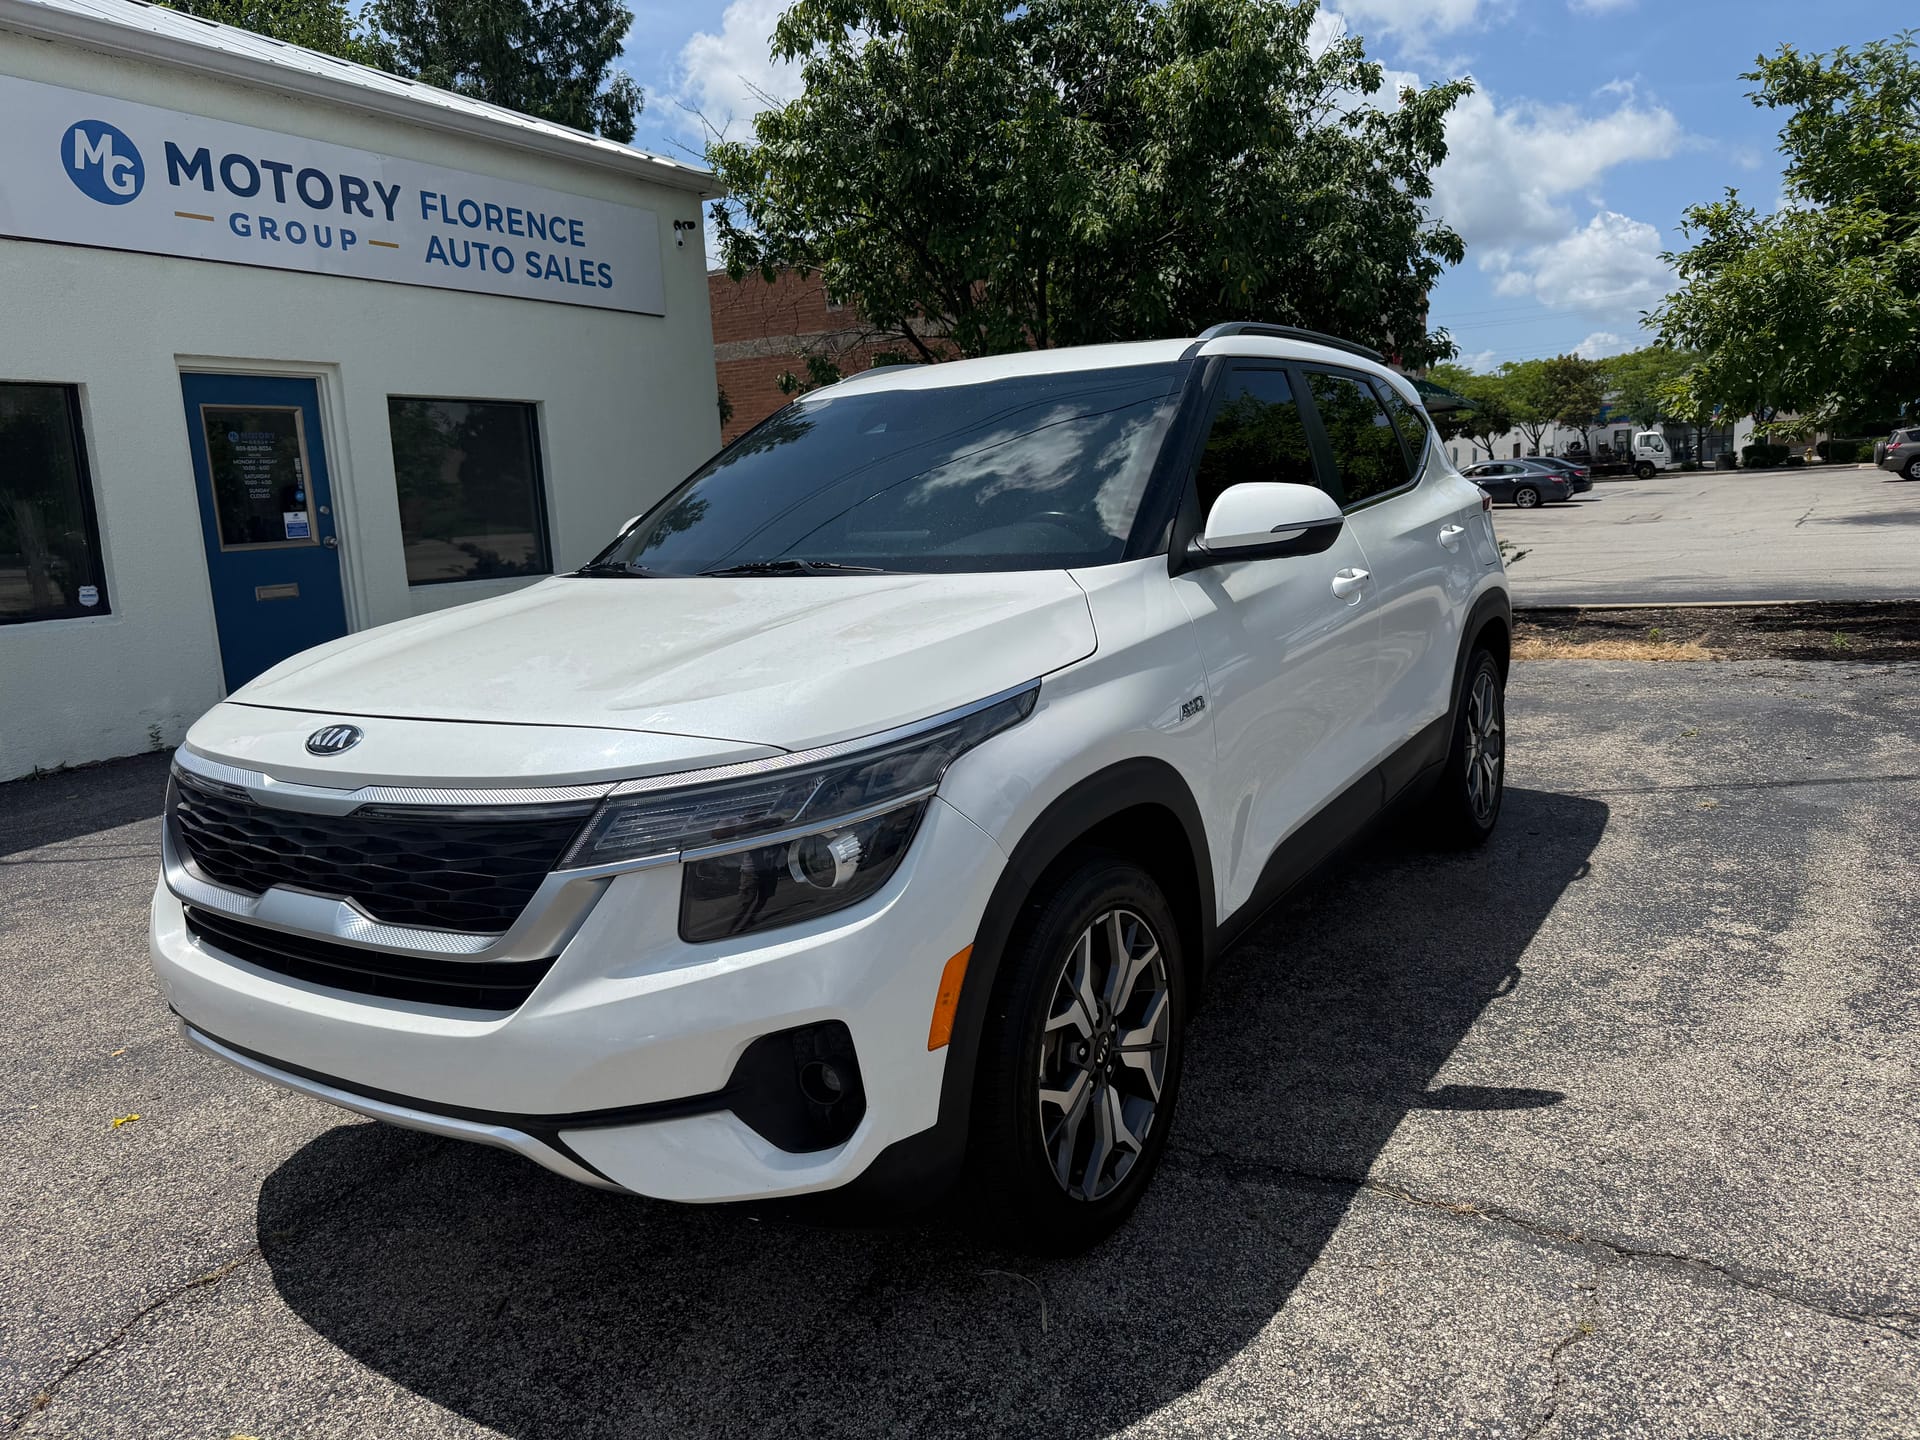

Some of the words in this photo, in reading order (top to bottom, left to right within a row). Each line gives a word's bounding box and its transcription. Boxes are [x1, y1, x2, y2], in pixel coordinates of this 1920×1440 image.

[74, 128, 136, 196] MG
[164, 141, 401, 221] MOTORY
[229, 212, 357, 251] GROUP
[420, 190, 586, 247] FLORENCE
[425, 235, 515, 274] AUTO
[526, 251, 613, 289] SALES
[309, 728, 352, 748] KIA
